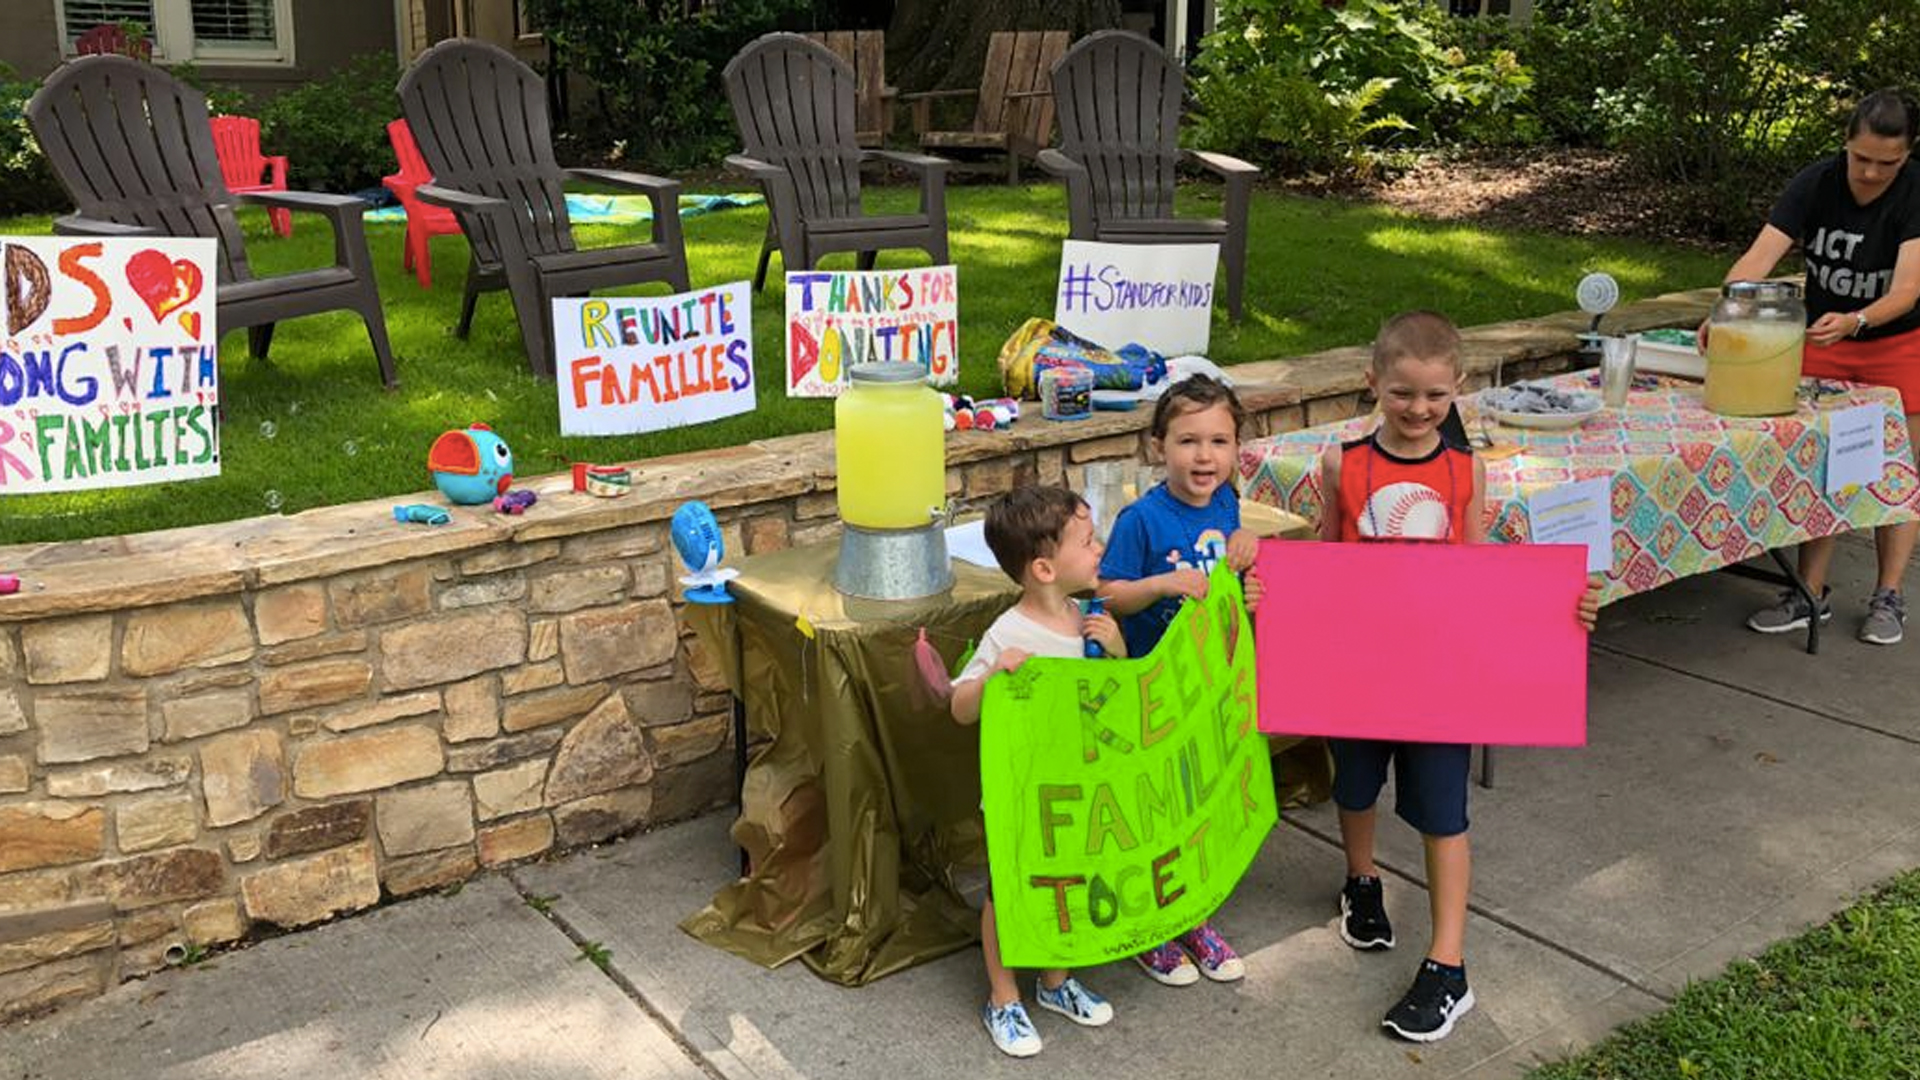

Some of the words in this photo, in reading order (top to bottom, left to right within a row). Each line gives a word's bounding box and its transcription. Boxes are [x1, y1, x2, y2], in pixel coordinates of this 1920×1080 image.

[581, 292, 735, 349] REUNITE
[788, 273, 914, 313] THANKS
[920, 272, 955, 307] FOR
[105, 345, 215, 399] WITH
[570, 339, 752, 409] FAMILIES
[35, 404, 220, 482] FAMILIES!
[1077, 608, 1214, 763] KEEP
[1038, 672, 1253, 857] FAMILIES
